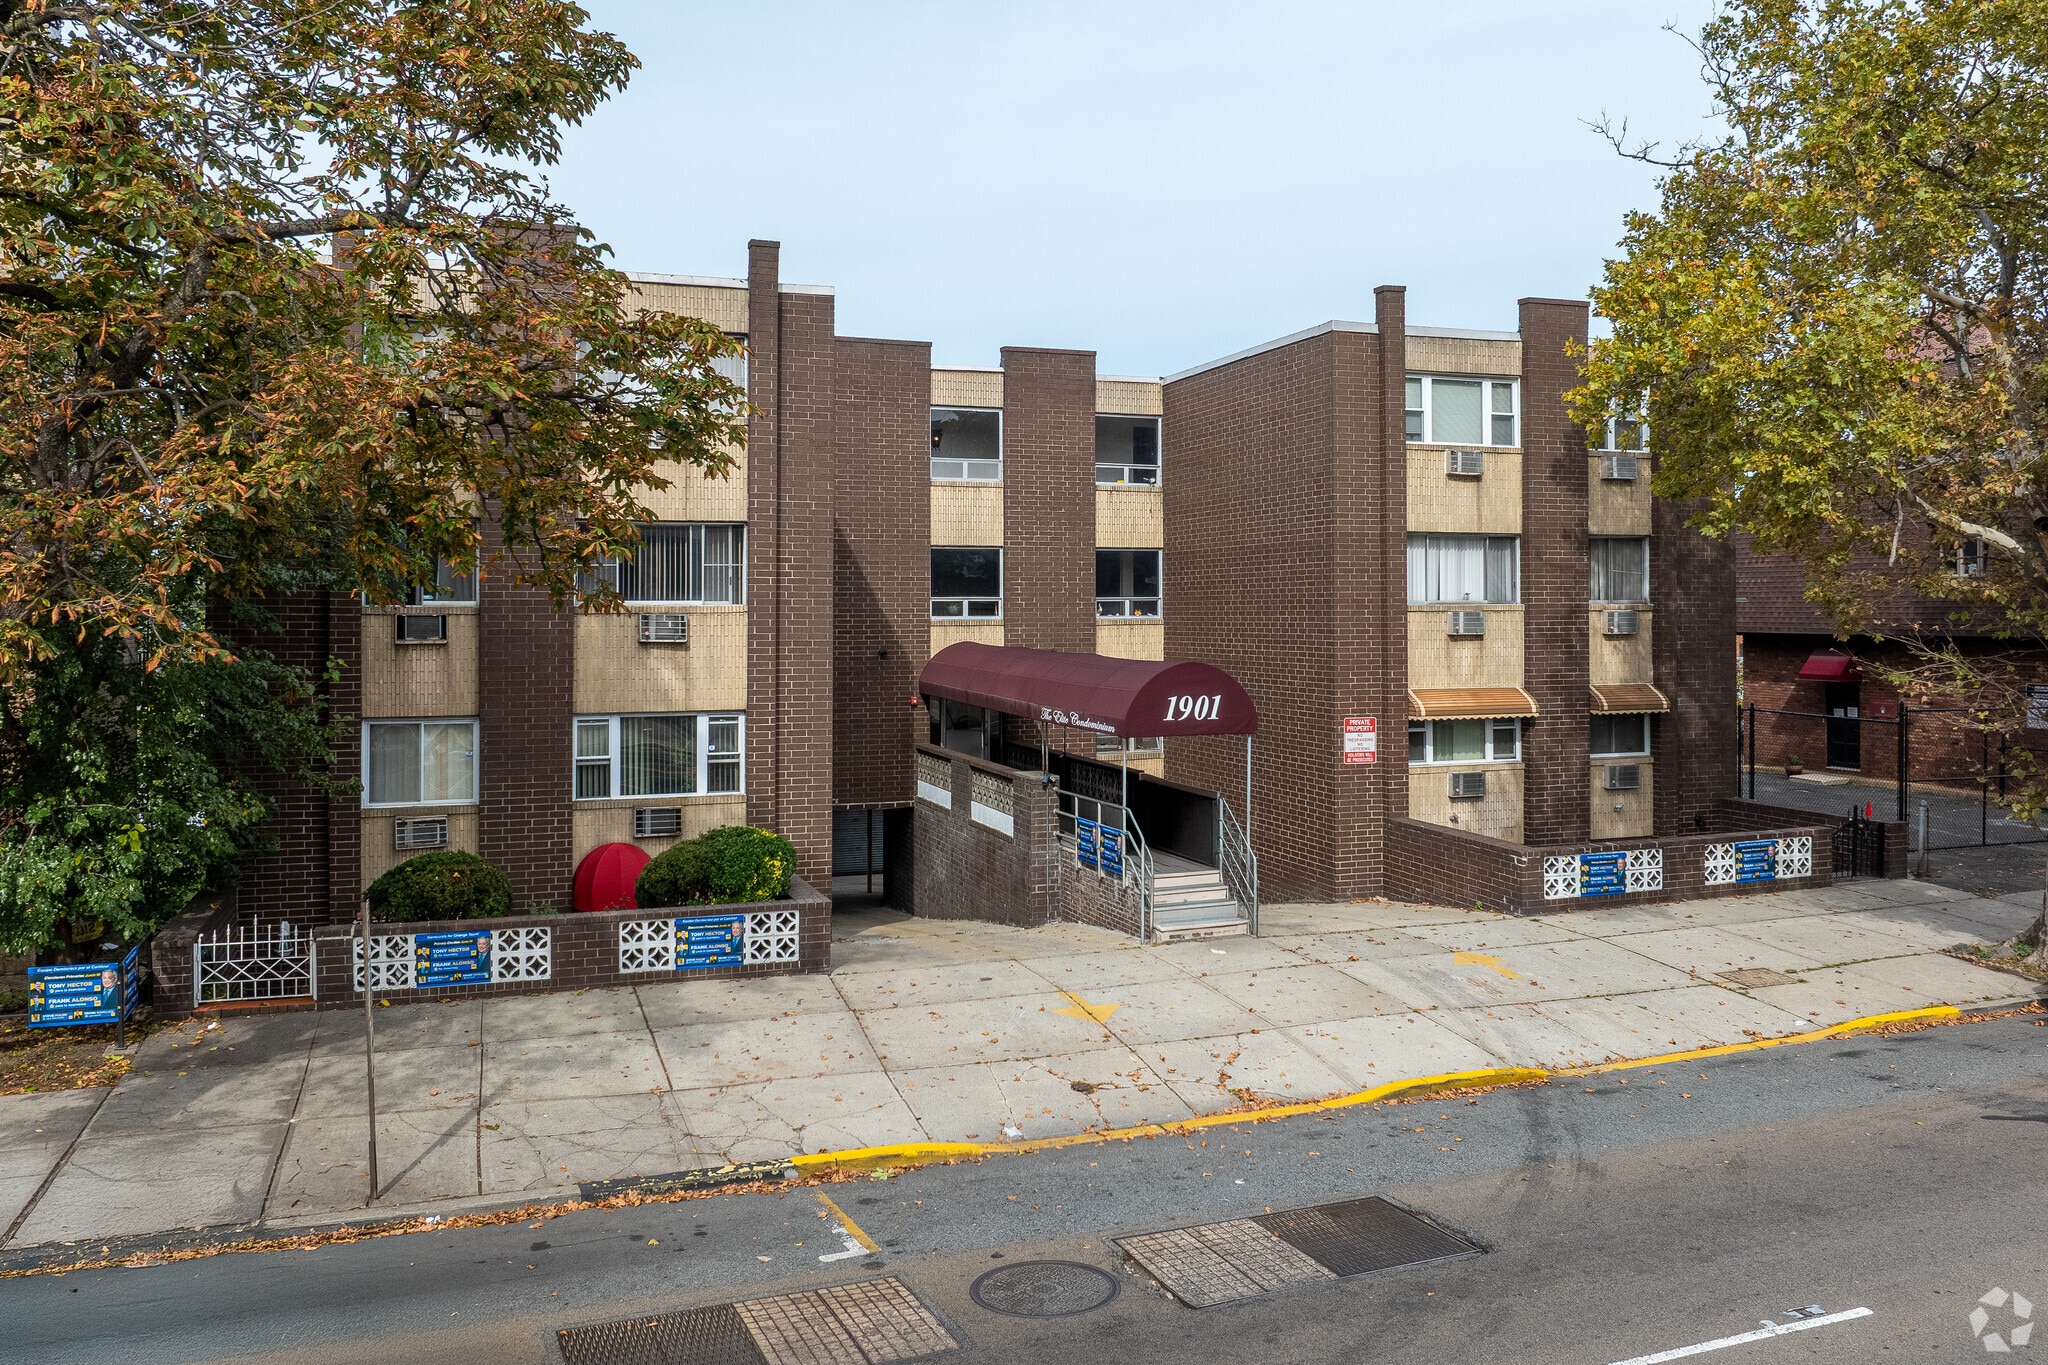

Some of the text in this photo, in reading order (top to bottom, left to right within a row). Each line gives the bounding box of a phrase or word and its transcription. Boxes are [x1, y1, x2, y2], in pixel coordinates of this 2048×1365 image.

[1040, 707, 1116, 733] The Elite Condominium
[1163, 694, 1222, 721] 1901
